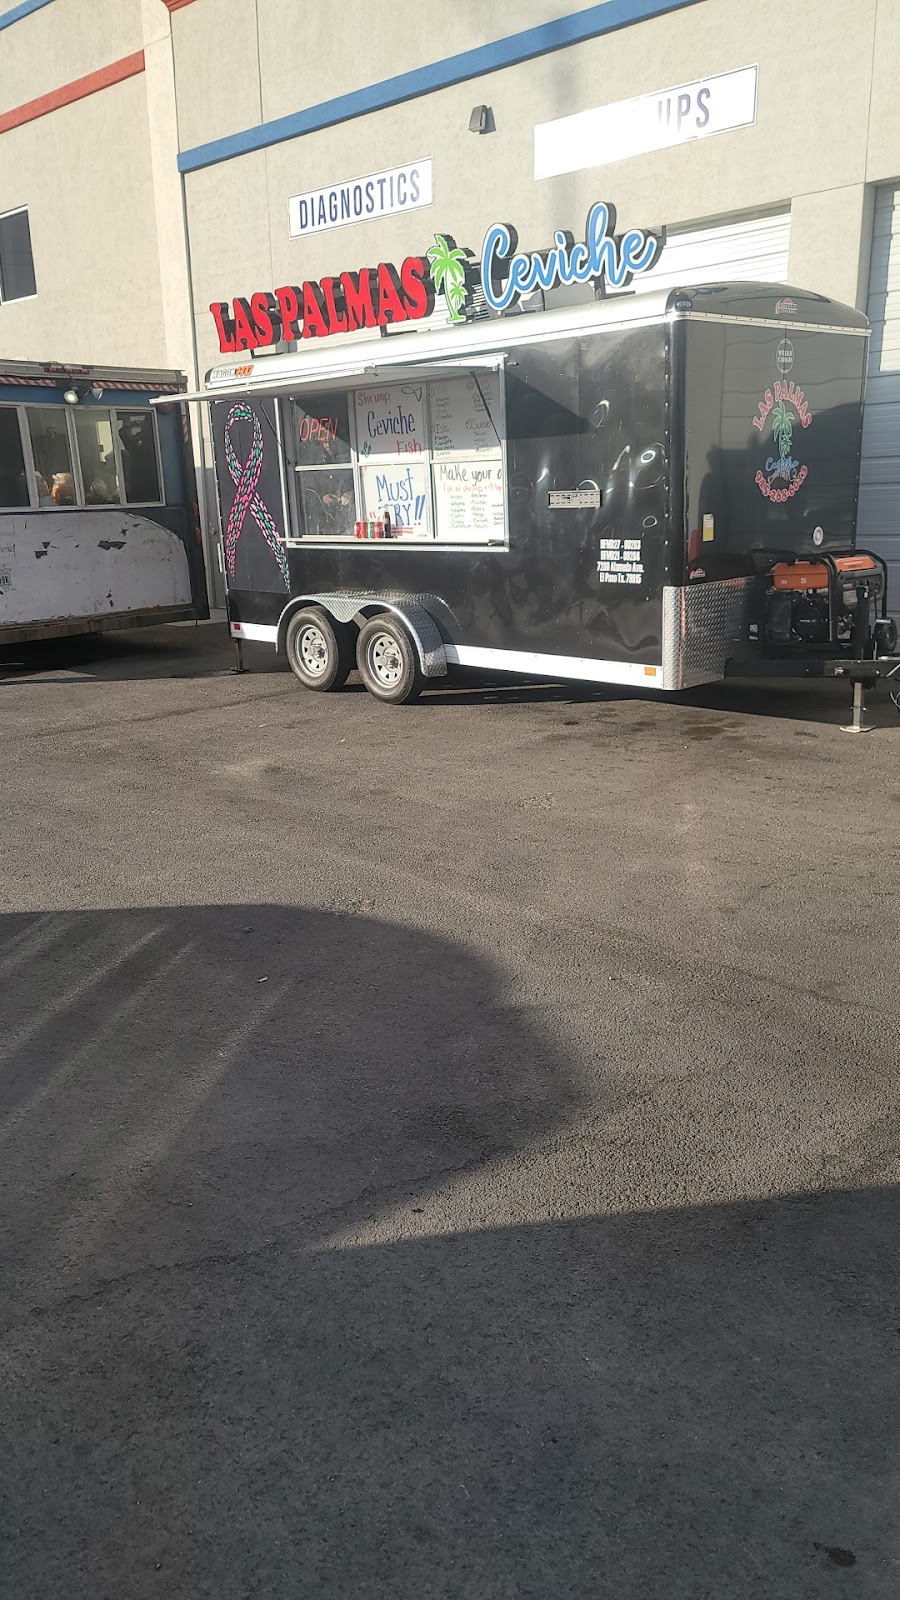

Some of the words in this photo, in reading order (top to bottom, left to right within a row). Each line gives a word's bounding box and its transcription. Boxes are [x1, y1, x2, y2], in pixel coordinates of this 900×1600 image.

[299, 169, 421, 229] DIAGNOSTICS
[210, 291, 279, 353] LAS
[275, 256, 434, 342] PALMAS
[481, 201, 660, 311] Ceviche
[357, 392, 390, 406] Shrimp
[753, 388, 773, 431] LAS
[774, 380, 812, 428] PALMAS
[300, 418, 338, 443] OPEN
[367, 405, 416, 438] Ceviche
[396, 439, 422, 456] Fish
[376, 468, 414, 502] Must
[440, 464, 468, 482] Make
[471, 470, 492, 487] your
